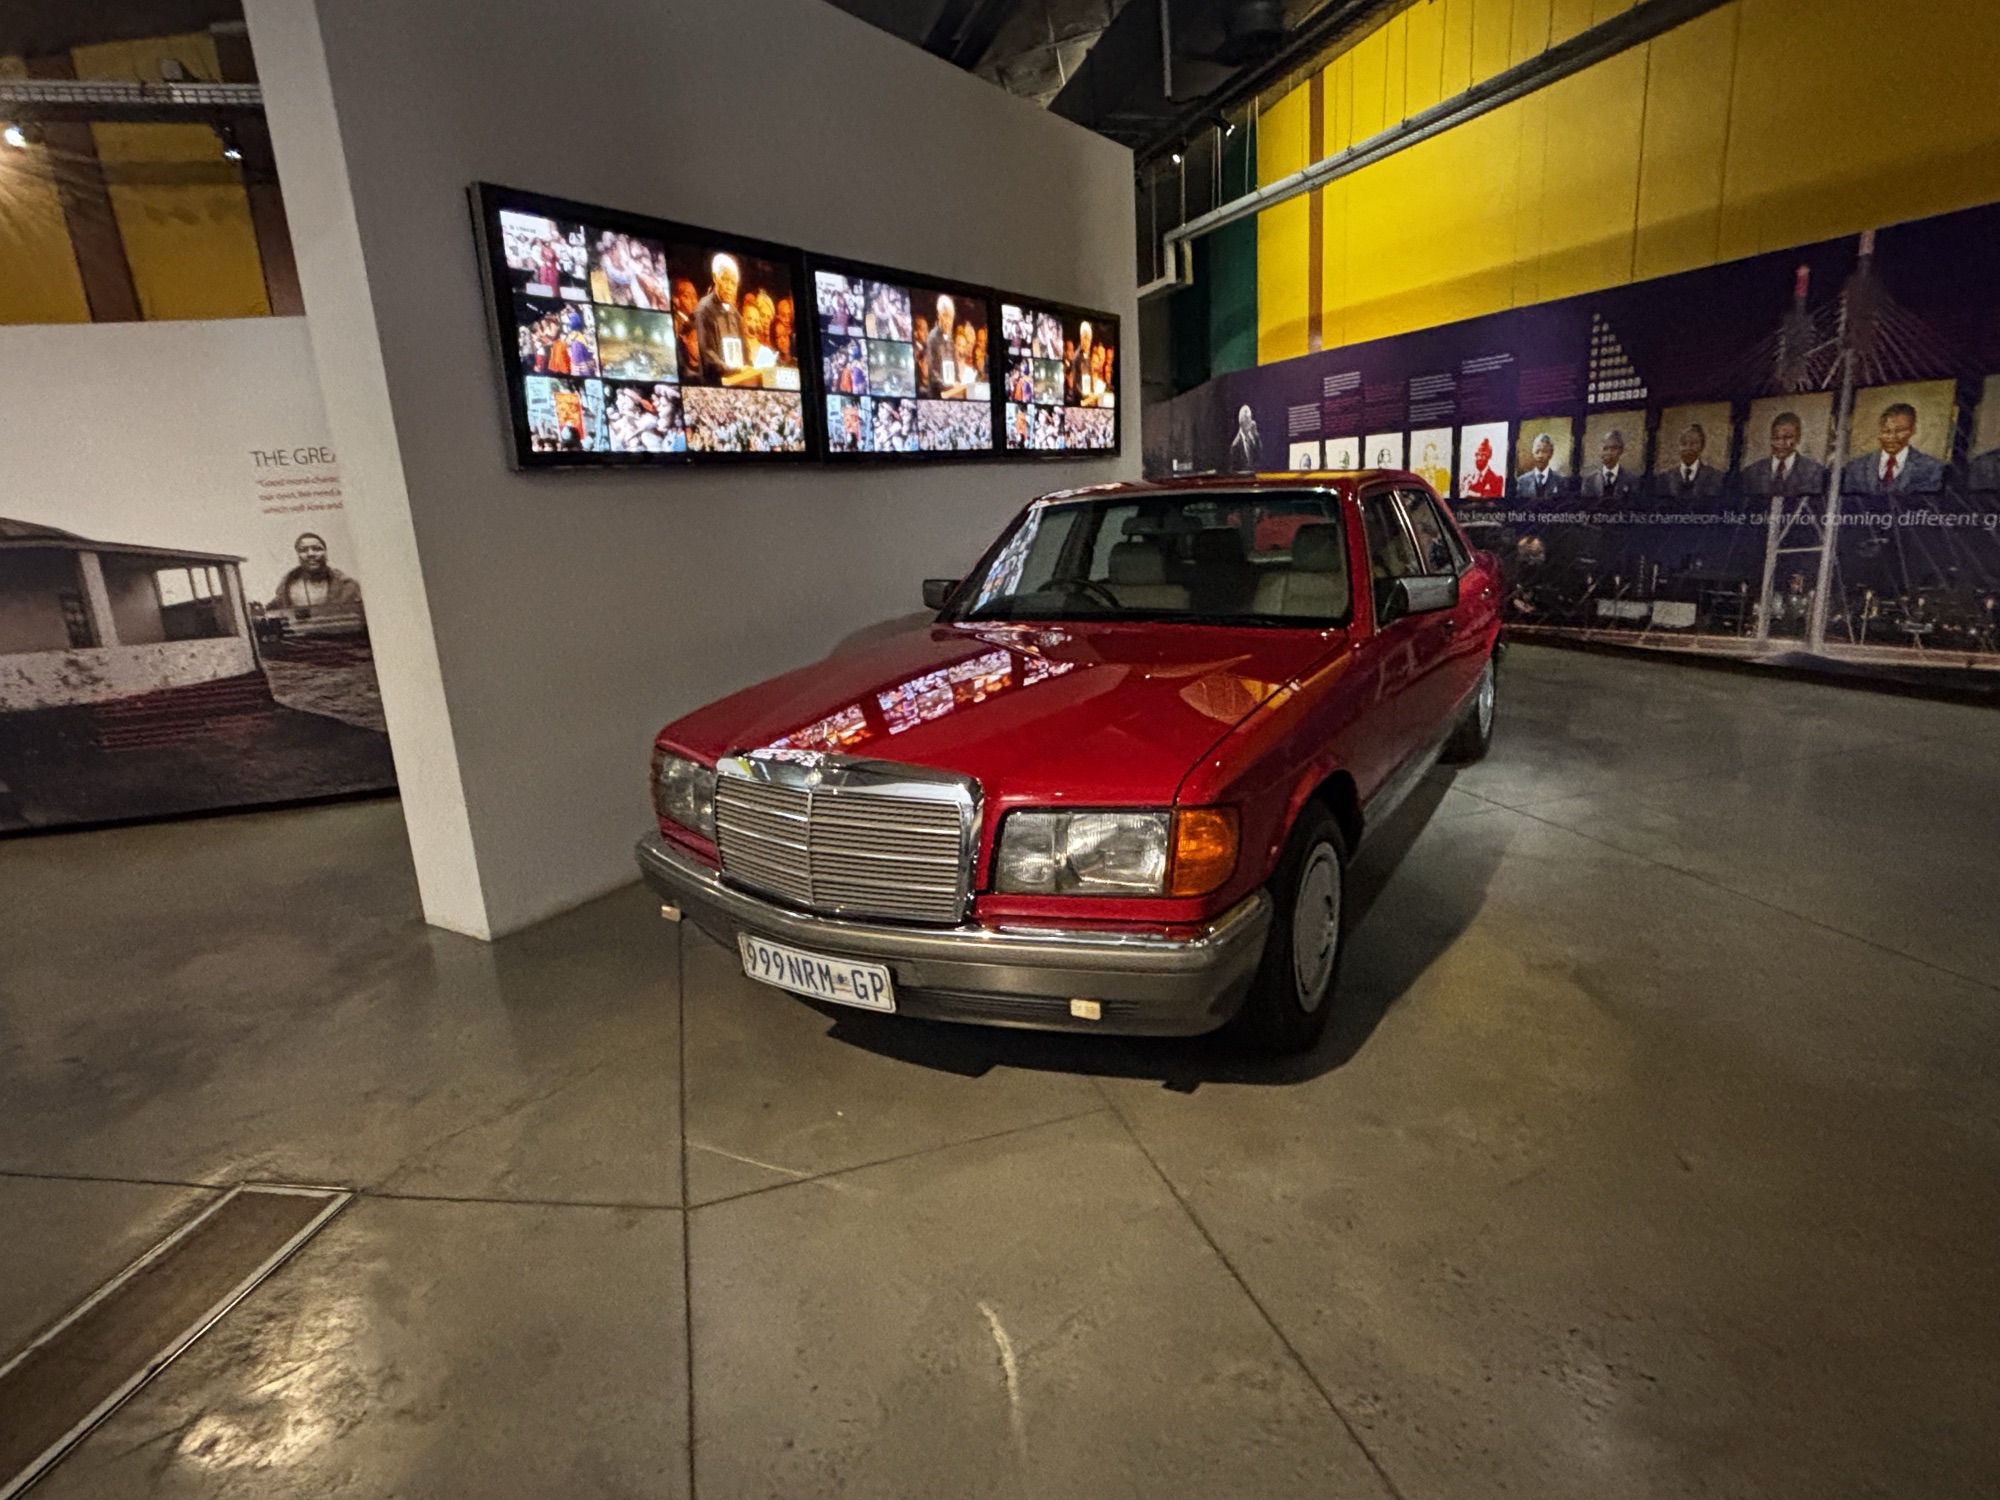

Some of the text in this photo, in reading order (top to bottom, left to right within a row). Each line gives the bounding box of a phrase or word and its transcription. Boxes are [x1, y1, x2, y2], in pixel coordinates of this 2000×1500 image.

[249, 449, 290, 467] THE
[1508, 510, 1527, 523] that
[1528, 511, 1536, 522] is
[1538, 510, 1590, 526] repeatedly
[1629, 510, 1647, 524] his
[1648, 510, 1747, 525] chameleon-like
[1897, 509, 1980, 526] different
[1983, 513, 2000, 531] g
[745, 941, 885, 1003] 999NRM GP
